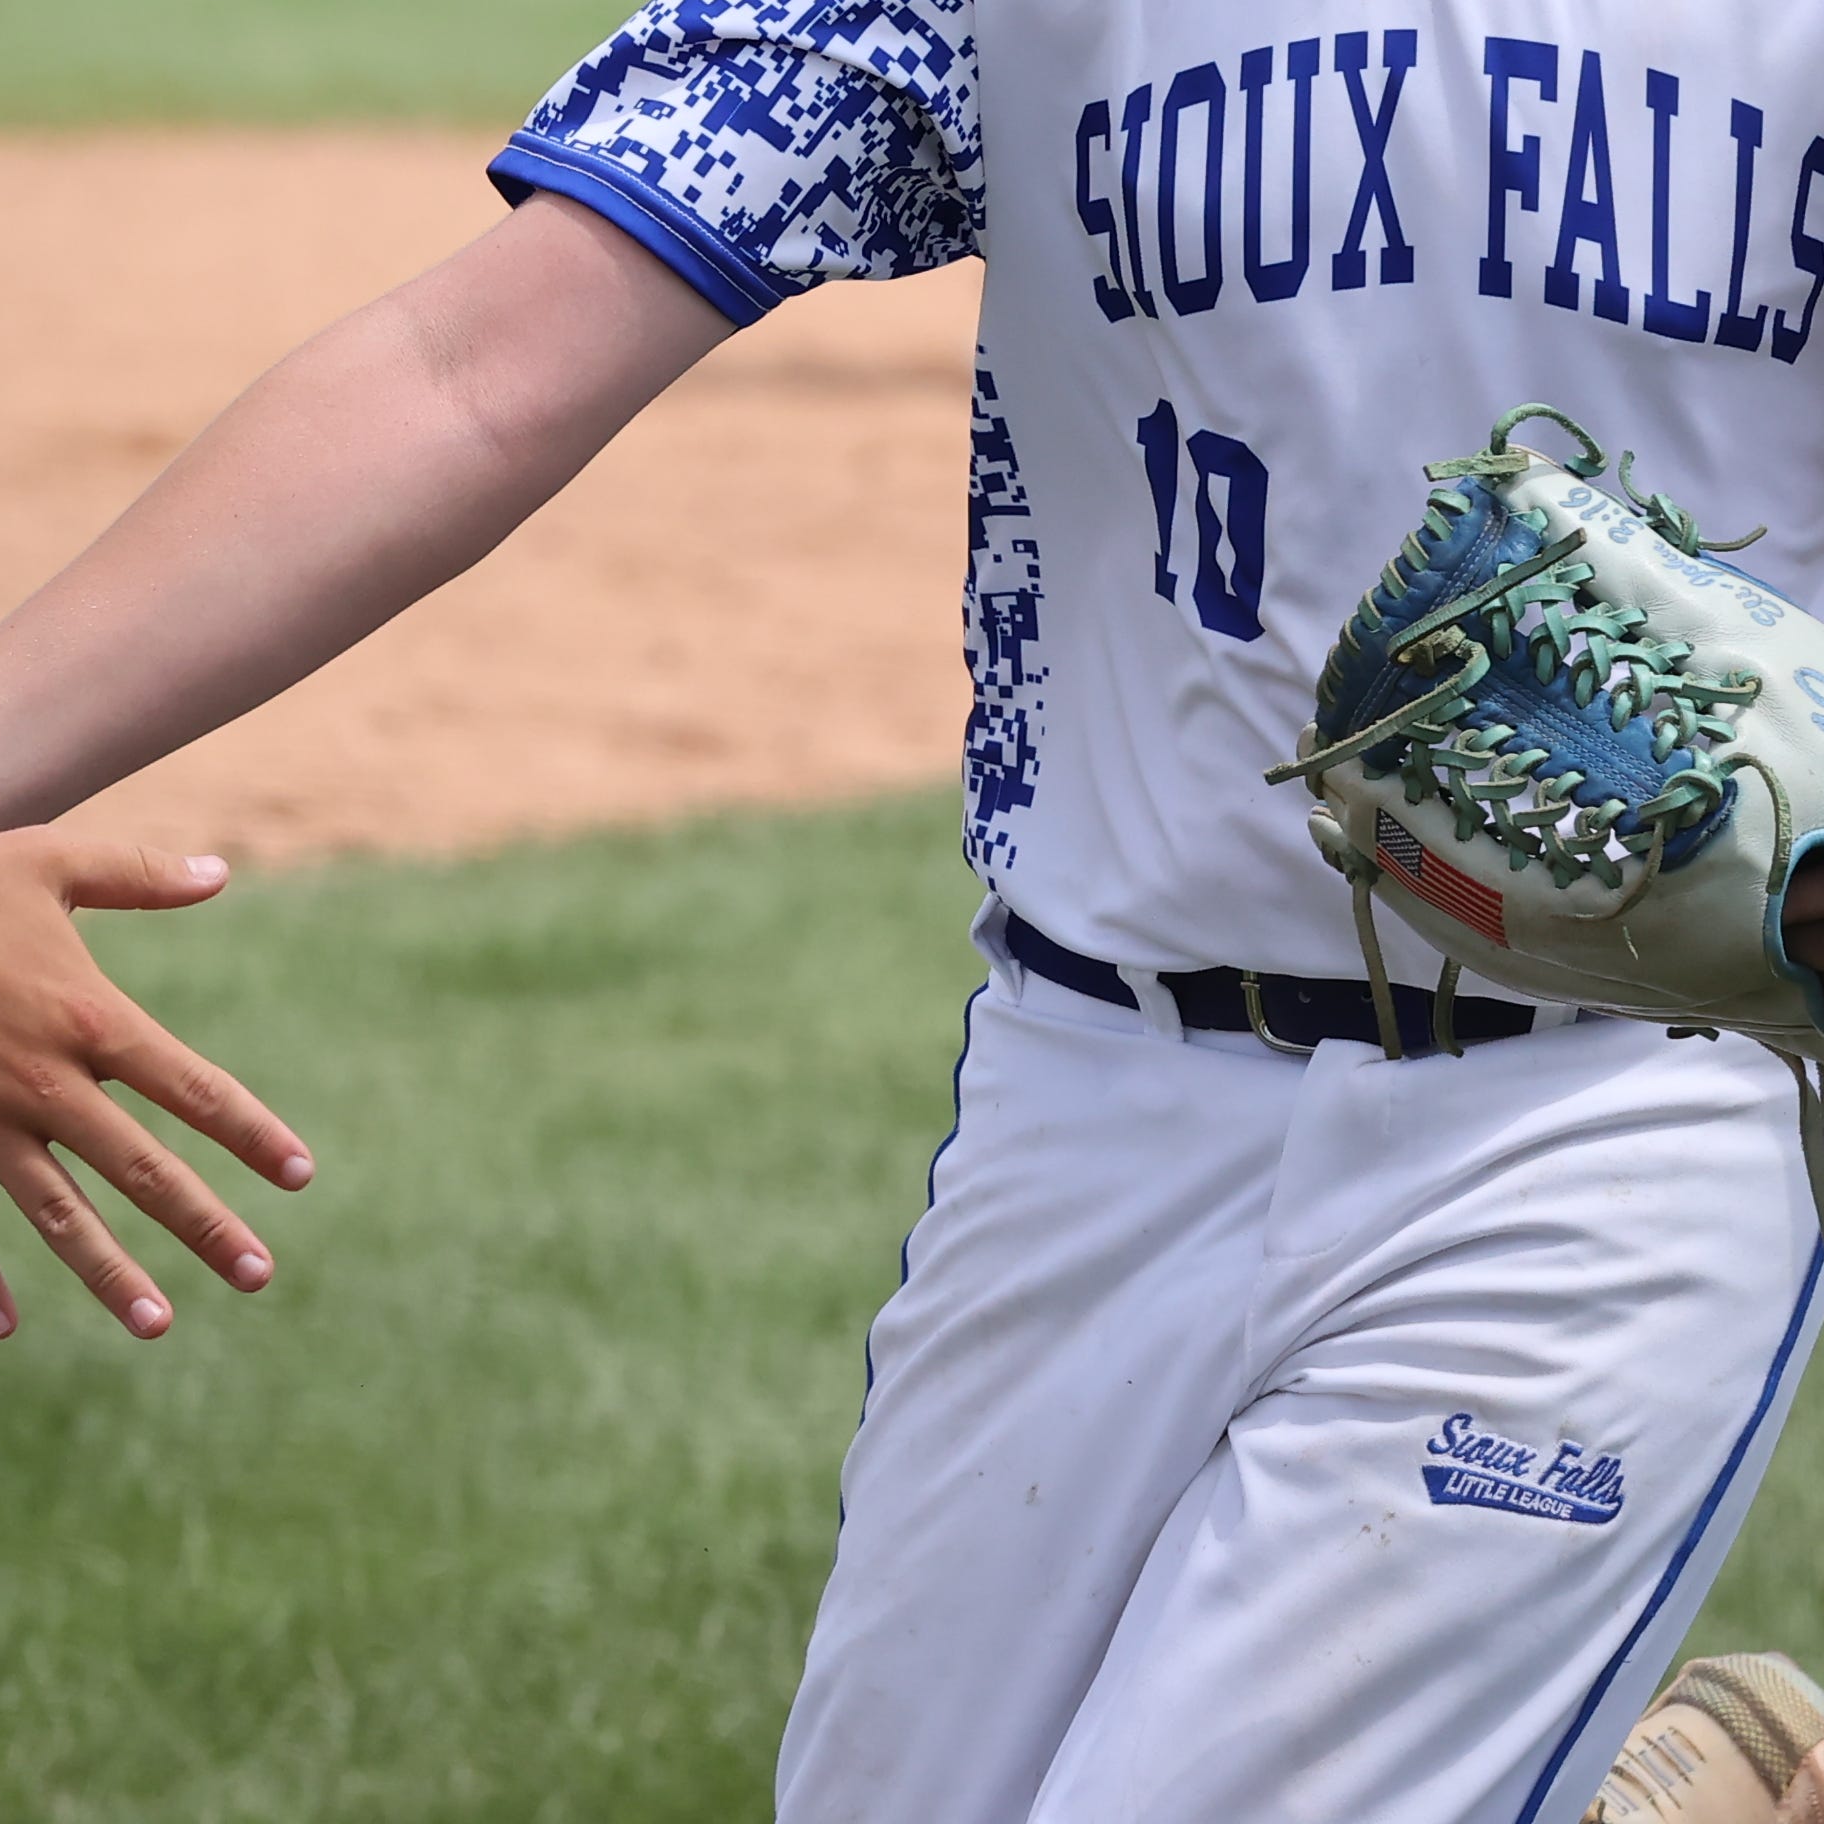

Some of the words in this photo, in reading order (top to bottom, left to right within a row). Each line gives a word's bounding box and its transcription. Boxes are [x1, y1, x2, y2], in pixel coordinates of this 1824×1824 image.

[1075, 28, 1419, 324] SIOUX
[1136, 397, 1270, 644] 10
[1558, 486, 1645, 545] 3:16
[1426, 1411, 1537, 1477] Sioux
[1538, 1438, 1625, 1504] Falls
[1443, 1470, 1507, 1501] LITTLE
[1508, 1486, 1574, 1519] LEAGUE
